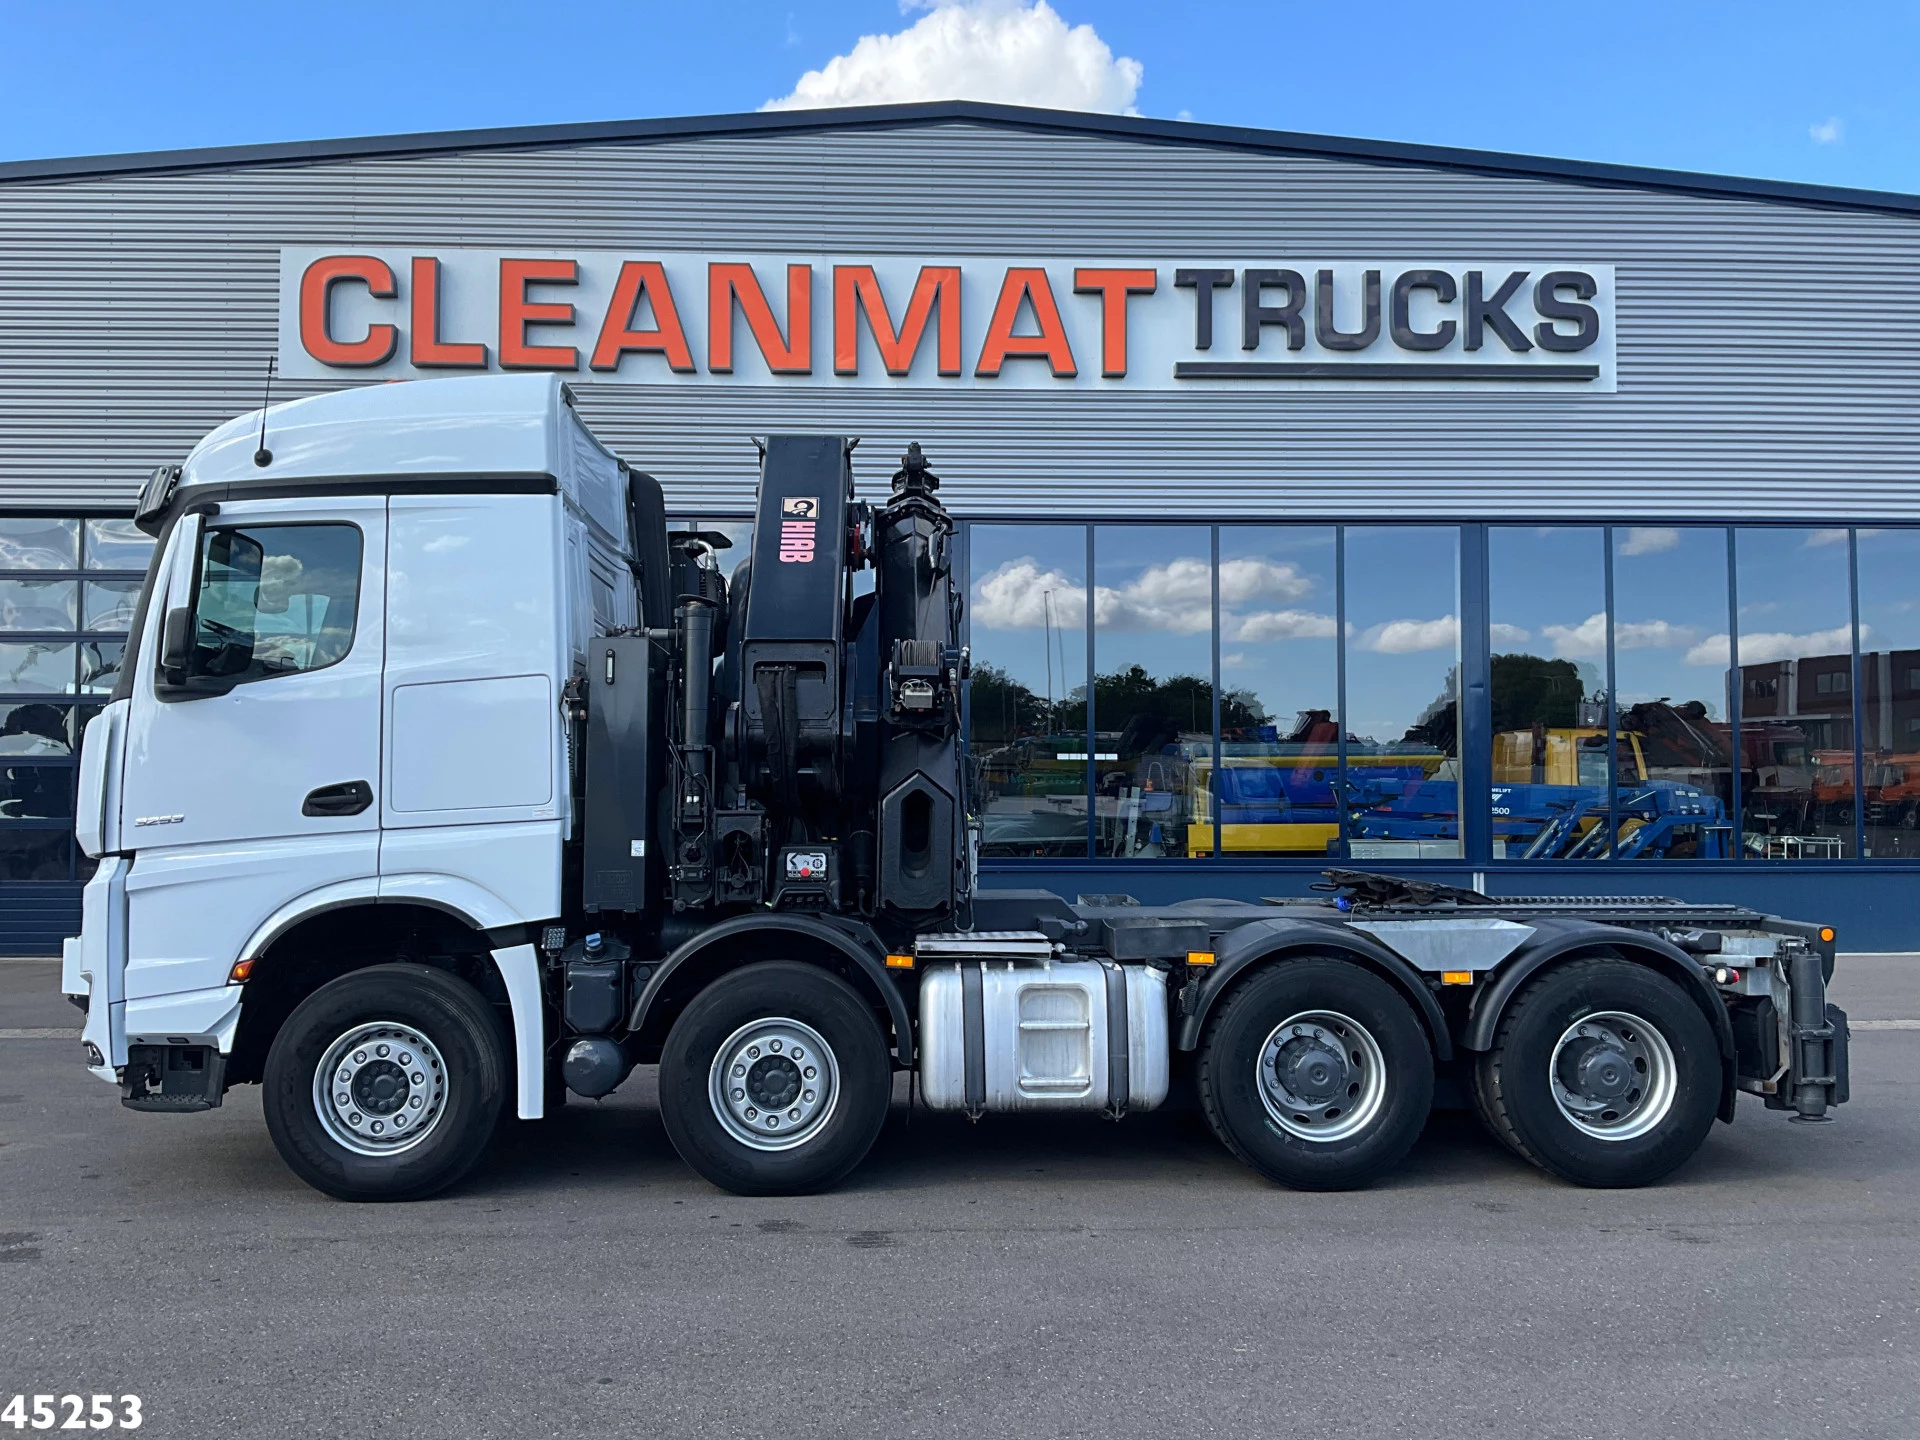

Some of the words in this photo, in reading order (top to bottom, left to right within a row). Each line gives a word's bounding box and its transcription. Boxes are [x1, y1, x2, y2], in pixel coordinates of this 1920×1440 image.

[300, 254, 1157, 377] CLEANMAT
[1174, 268, 1600, 352] TRUCKS
[779, 521, 816, 562] HIAB
